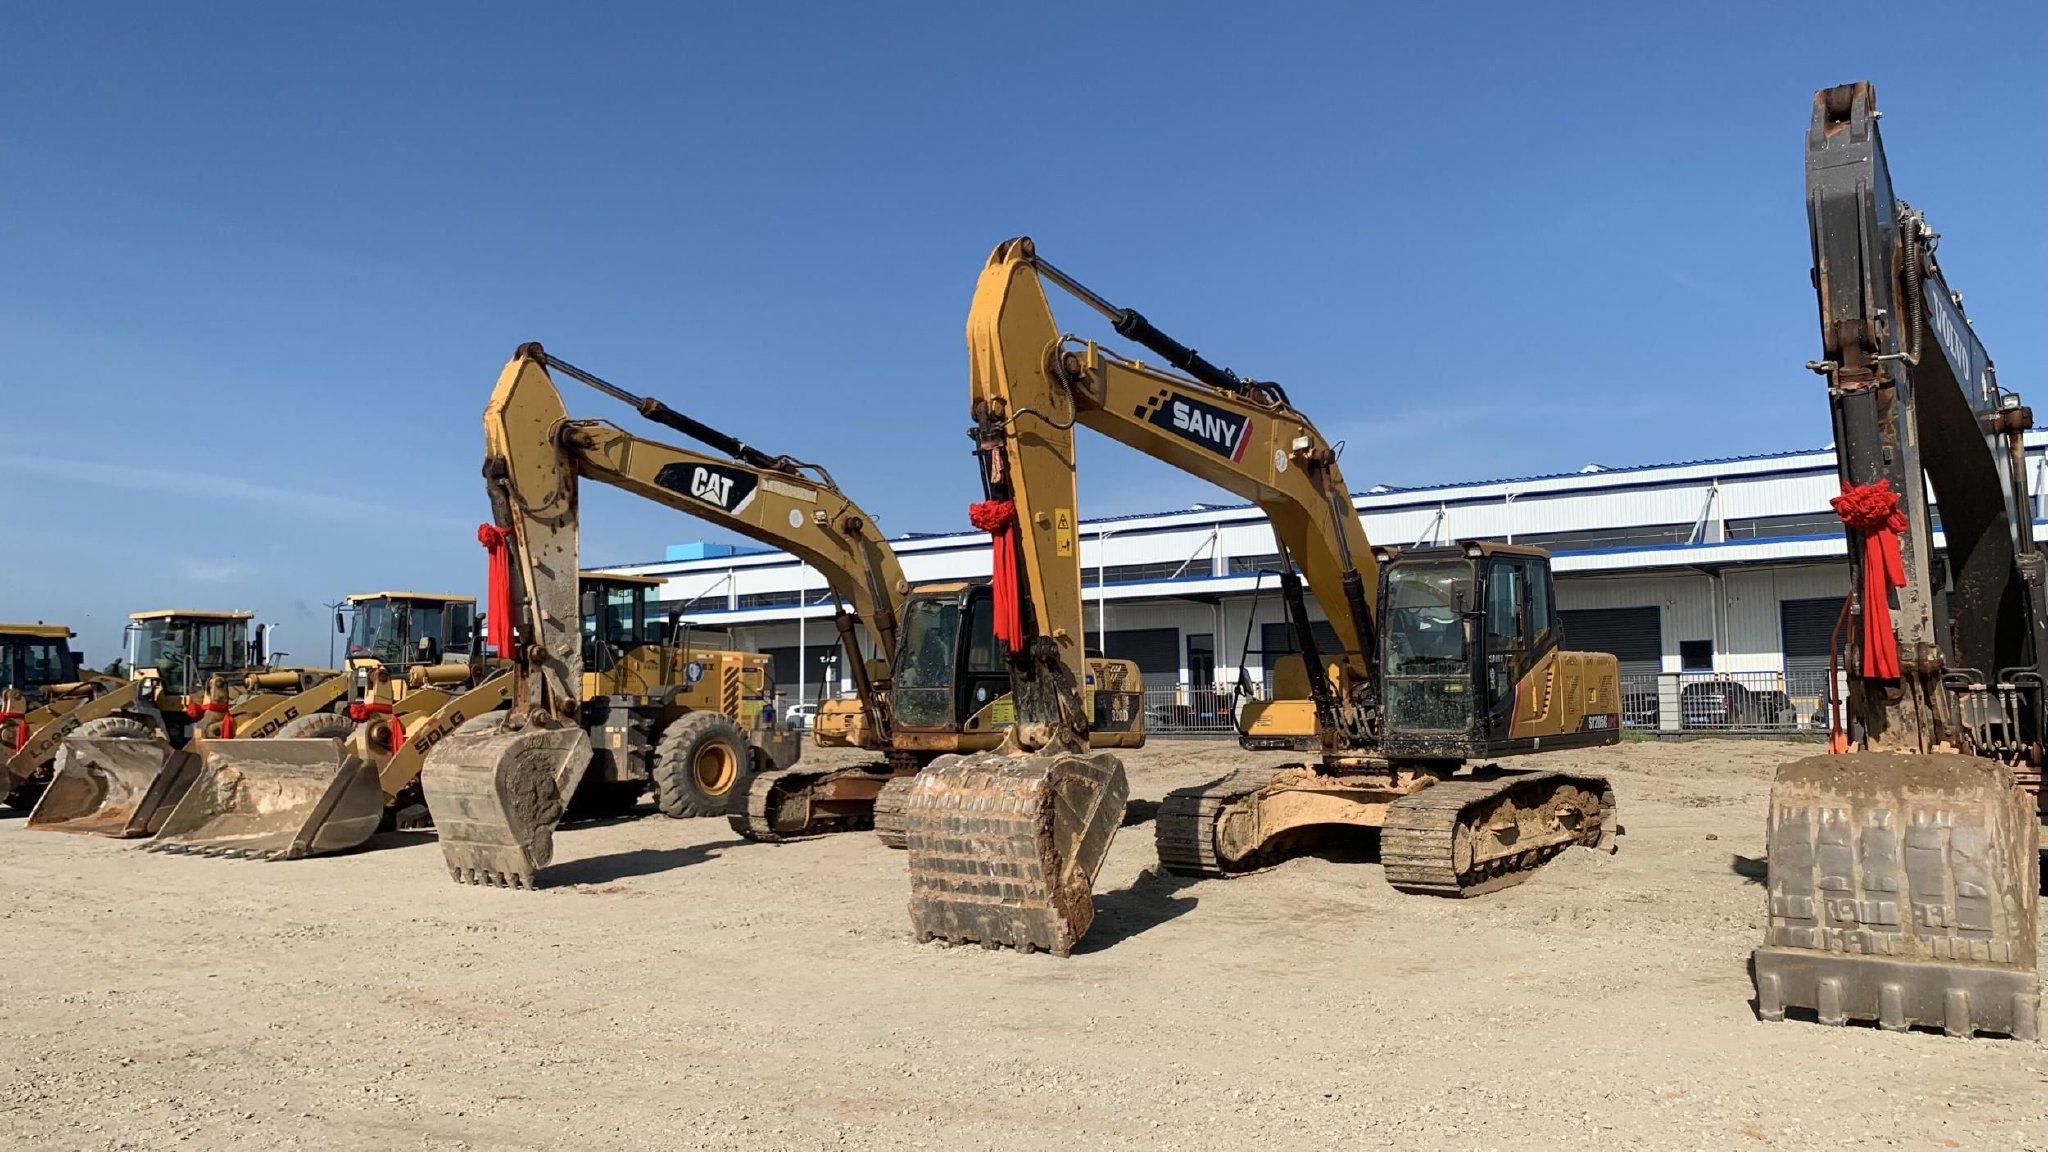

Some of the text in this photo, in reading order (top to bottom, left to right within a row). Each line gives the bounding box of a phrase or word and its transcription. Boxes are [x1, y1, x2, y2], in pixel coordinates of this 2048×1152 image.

[1932, 291, 1970, 381] VOLVO
[1173, 401, 1237, 447] SANY
[690, 467, 734, 507] CAT
[250, 706, 300, 738] SDLG
[414, 710, 465, 754] SDLG
[1111, 709, 1129, 722] 320D
[29, 718, 81, 759] LG953
